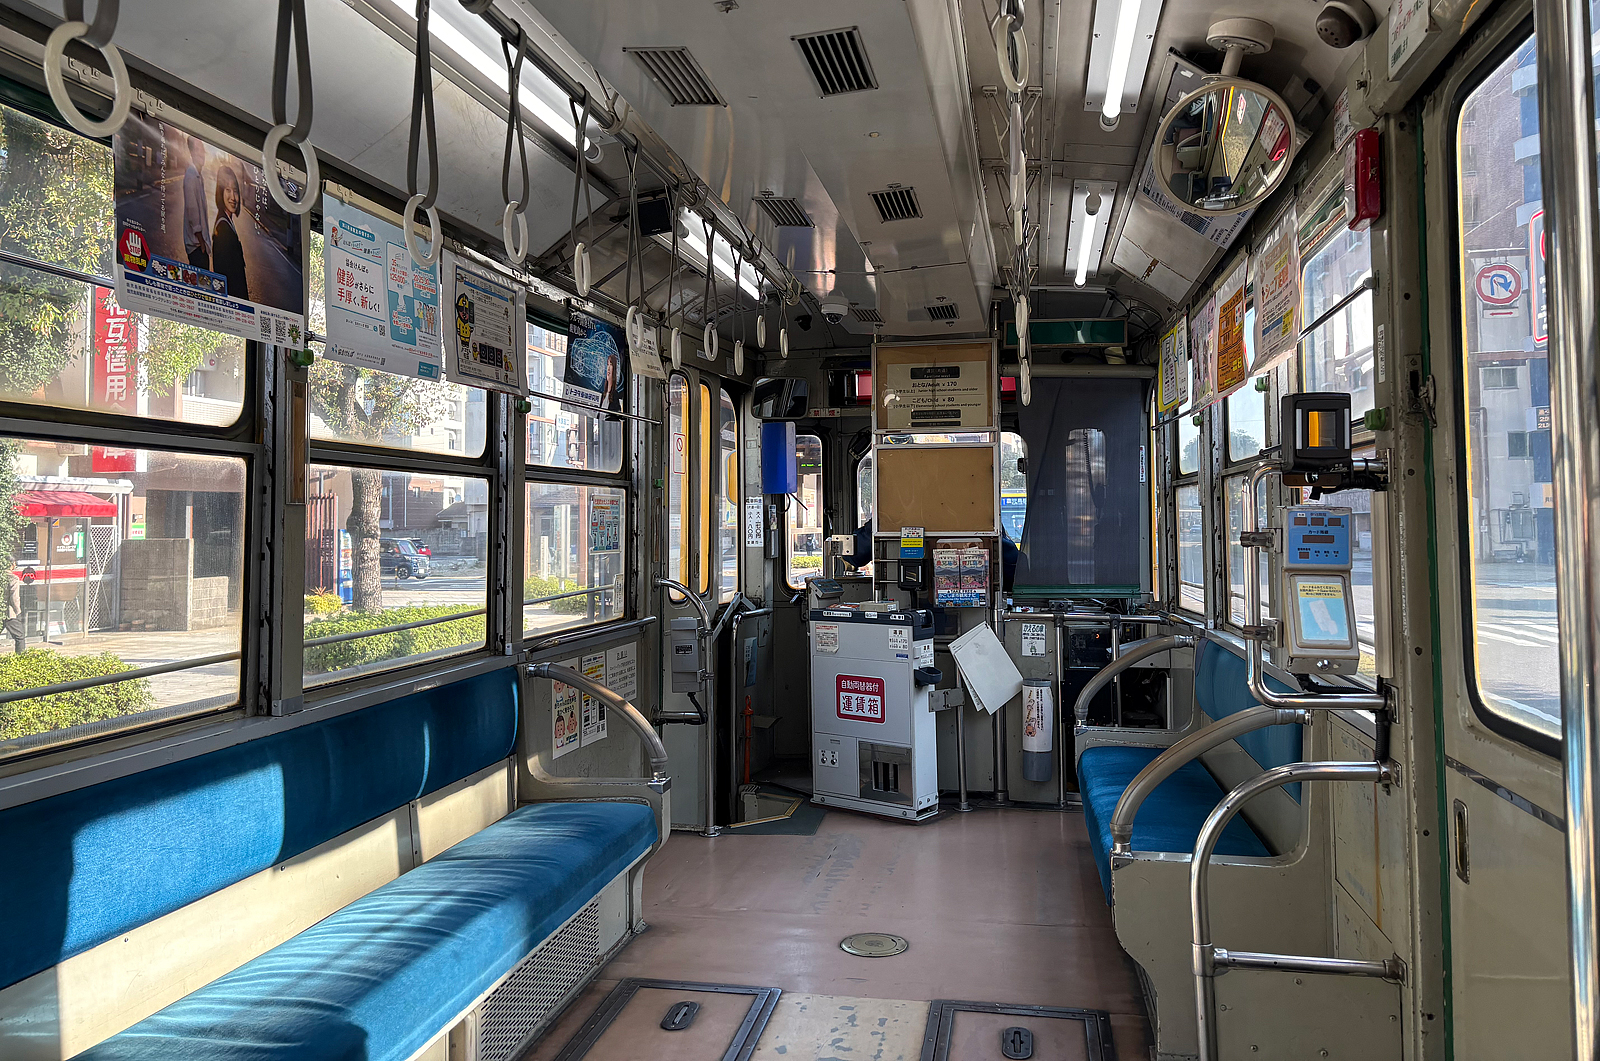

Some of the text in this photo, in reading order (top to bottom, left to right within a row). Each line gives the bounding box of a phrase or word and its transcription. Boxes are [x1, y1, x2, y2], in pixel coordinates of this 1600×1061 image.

[130, 245, 141, 254] STOP
[336, 267, 375, 294] 健診がさらに
[337, 287, 380, 313] 手厚く、新しく!
[841, 679, 880, 693] 自動両替器付
[842, 695, 879, 715] 運賃箱
